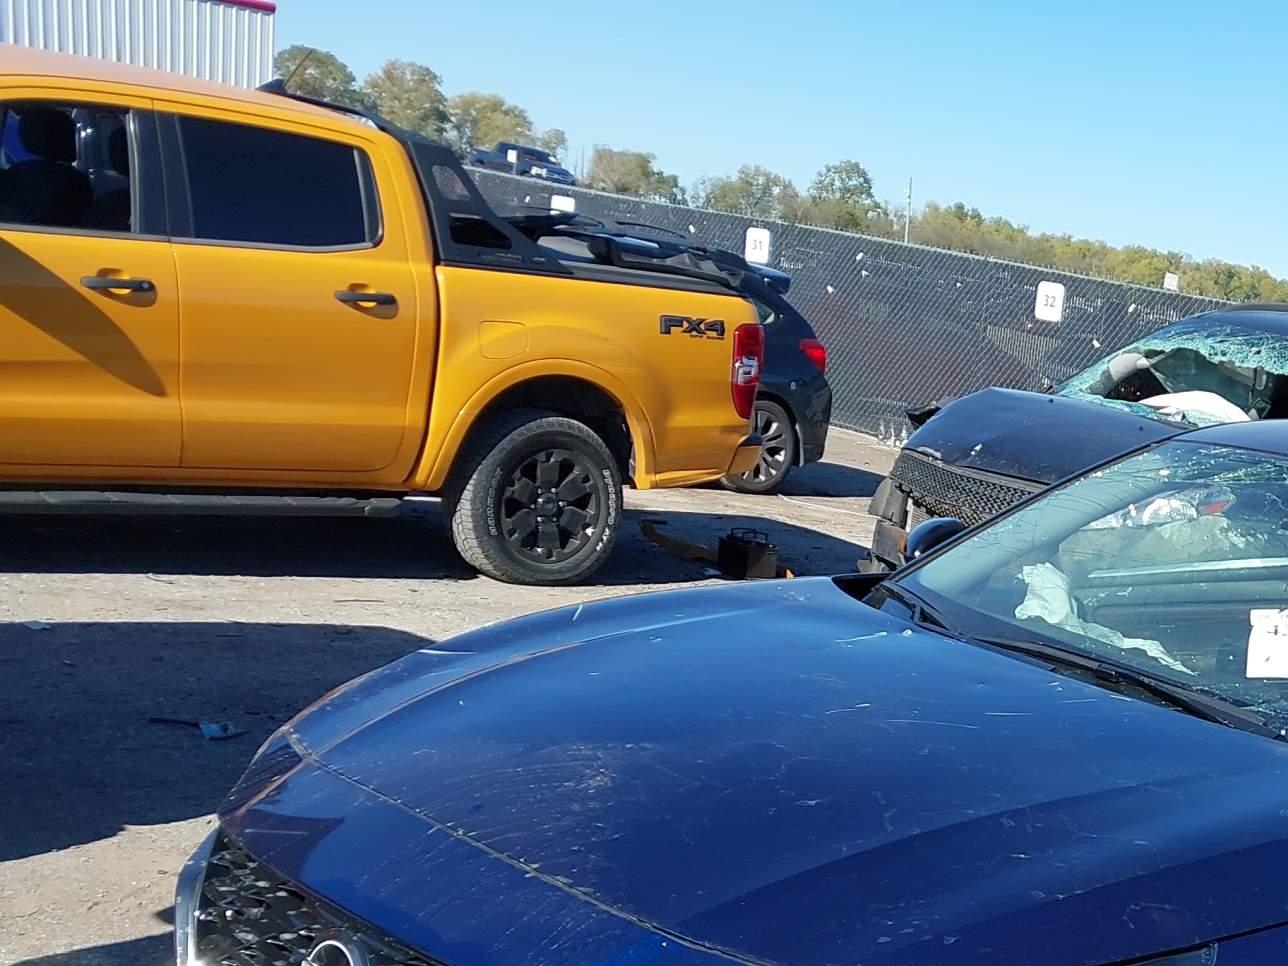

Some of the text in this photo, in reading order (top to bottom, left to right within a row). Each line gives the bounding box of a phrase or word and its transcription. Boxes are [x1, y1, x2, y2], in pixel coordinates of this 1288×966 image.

[751, 239, 763, 251] 31
[1043, 294, 1056, 308] 32
[659, 314, 726, 337] FX4
